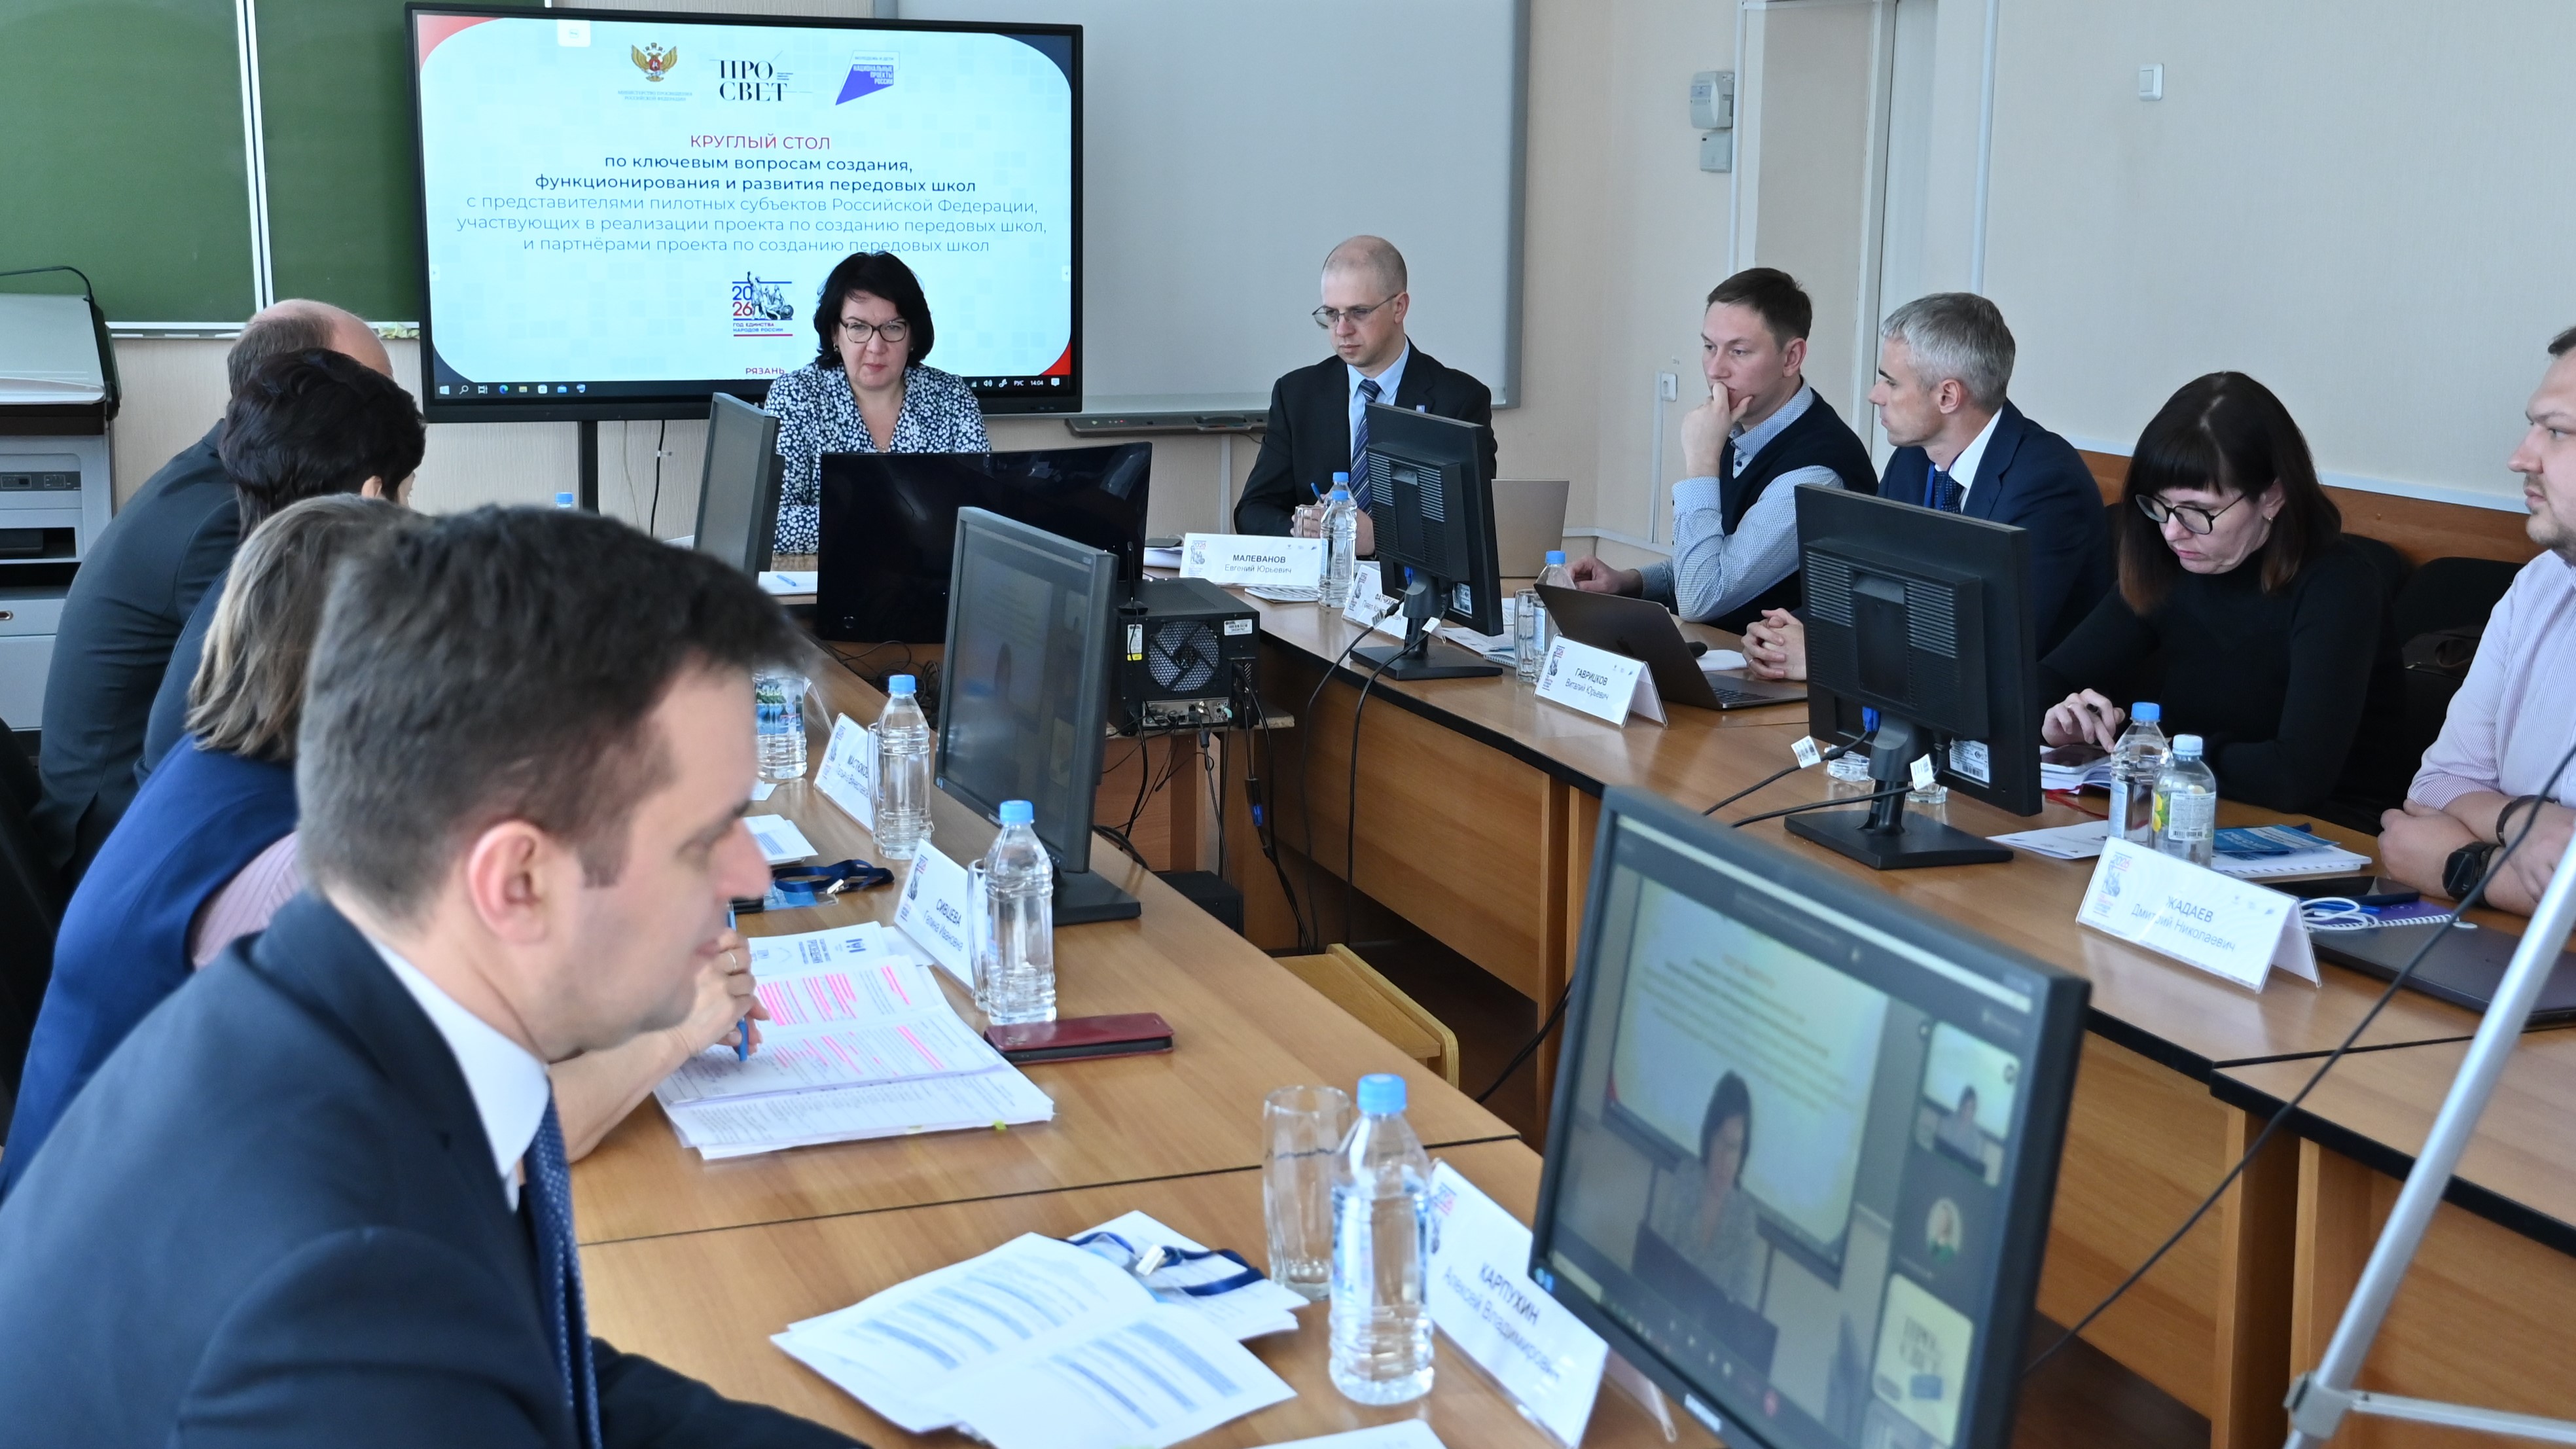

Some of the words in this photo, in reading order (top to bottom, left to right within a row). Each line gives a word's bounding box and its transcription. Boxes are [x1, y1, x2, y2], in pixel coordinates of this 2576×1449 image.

[719, 60, 773, 80] ПРО
[719, 81, 787, 101] СВЕТ
[691, 133, 776, 149] КРУГЛЫЙ
[783, 136, 831, 150] СТОЛ
[605, 157, 626, 168] по
[633, 157, 728, 169] ключевым
[734, 159, 821, 173] вопросам
[827, 160, 913, 174] создания,
[535, 173, 720, 191] функционирования
[726, 179, 736, 189] и
[742, 180, 824, 192] развития
[830, 181, 926, 194] передовых
[932, 182, 975, 192] школ
[467, 197, 476, 207] с
[482, 197, 644, 211] представителями
[650, 199, 735, 210] пилотных
[740, 198, 827, 213] субъектов
[832, 198, 933, 212] Российской
[938, 199, 1038, 216] Федерации,
[457, 218, 580, 232] участвующих
[586, 219, 594, 230] в
[601, 219, 708, 233] реализации
[715, 220, 784, 234] проекта
[790, 221, 810, 230] по
[815, 221, 899, 233] созданию
[905, 222, 995, 235] передовых
[1001, 223, 1046, 234] школ,
[524, 240, 533, 249] и
[541, 237, 651, 253] партнёрами
[657, 240, 728, 254] проекта
[734, 241, 753, 251] по
[759, 241, 844, 253] созданию
[850, 241, 942, 255] передовых
[947, 241, 990, 252] школ
[732, 285, 753, 300] 20
[732, 302, 753, 316] 26
[1232, 554, 1286, 564] МАЛЕВАНОВ
[1257, 565, 1292, 574] Юрьевич
[1575, 668, 1608, 686] ГАВРИЦКОВ
[1565, 678, 1586, 692] Виталий
[1585, 685, 1609, 700] Юрьевич
[2111, 853, 2131, 868] 2026
[936, 899, 961, 927] СИВЦЕВА
[2166, 895, 2213, 923] ЖАДАЕВ
[923, 910, 940, 933] Галина
[939, 923, 964, 952] Ивановна
[2174, 920, 2236, 952] Николаевич
[1443, 1265, 1482, 1312] Алексей
[1479, 1262, 1539, 1325] КАРПУХИН
